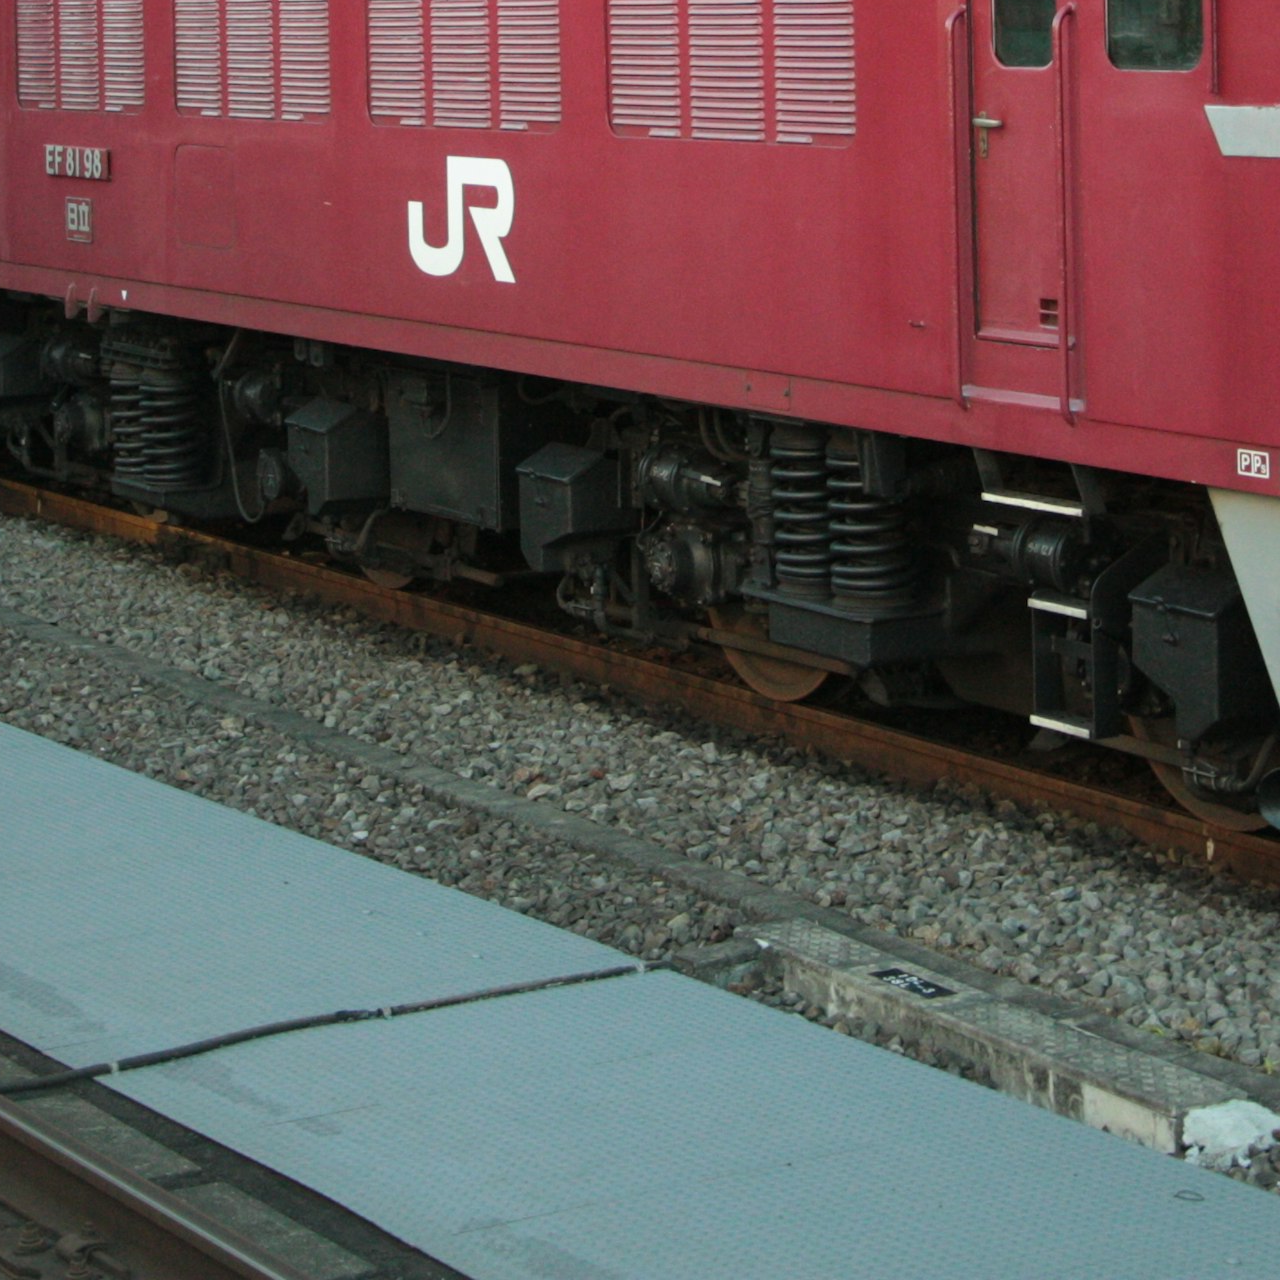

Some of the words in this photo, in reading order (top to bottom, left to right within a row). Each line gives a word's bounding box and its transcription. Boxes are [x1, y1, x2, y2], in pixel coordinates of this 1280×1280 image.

[45, 144, 64, 175] EF
[66, 147, 80, 177] 81
[83, 148, 102, 178] 98
[67, 201, 90, 232] 日立
[407, 155, 516, 283] JR
